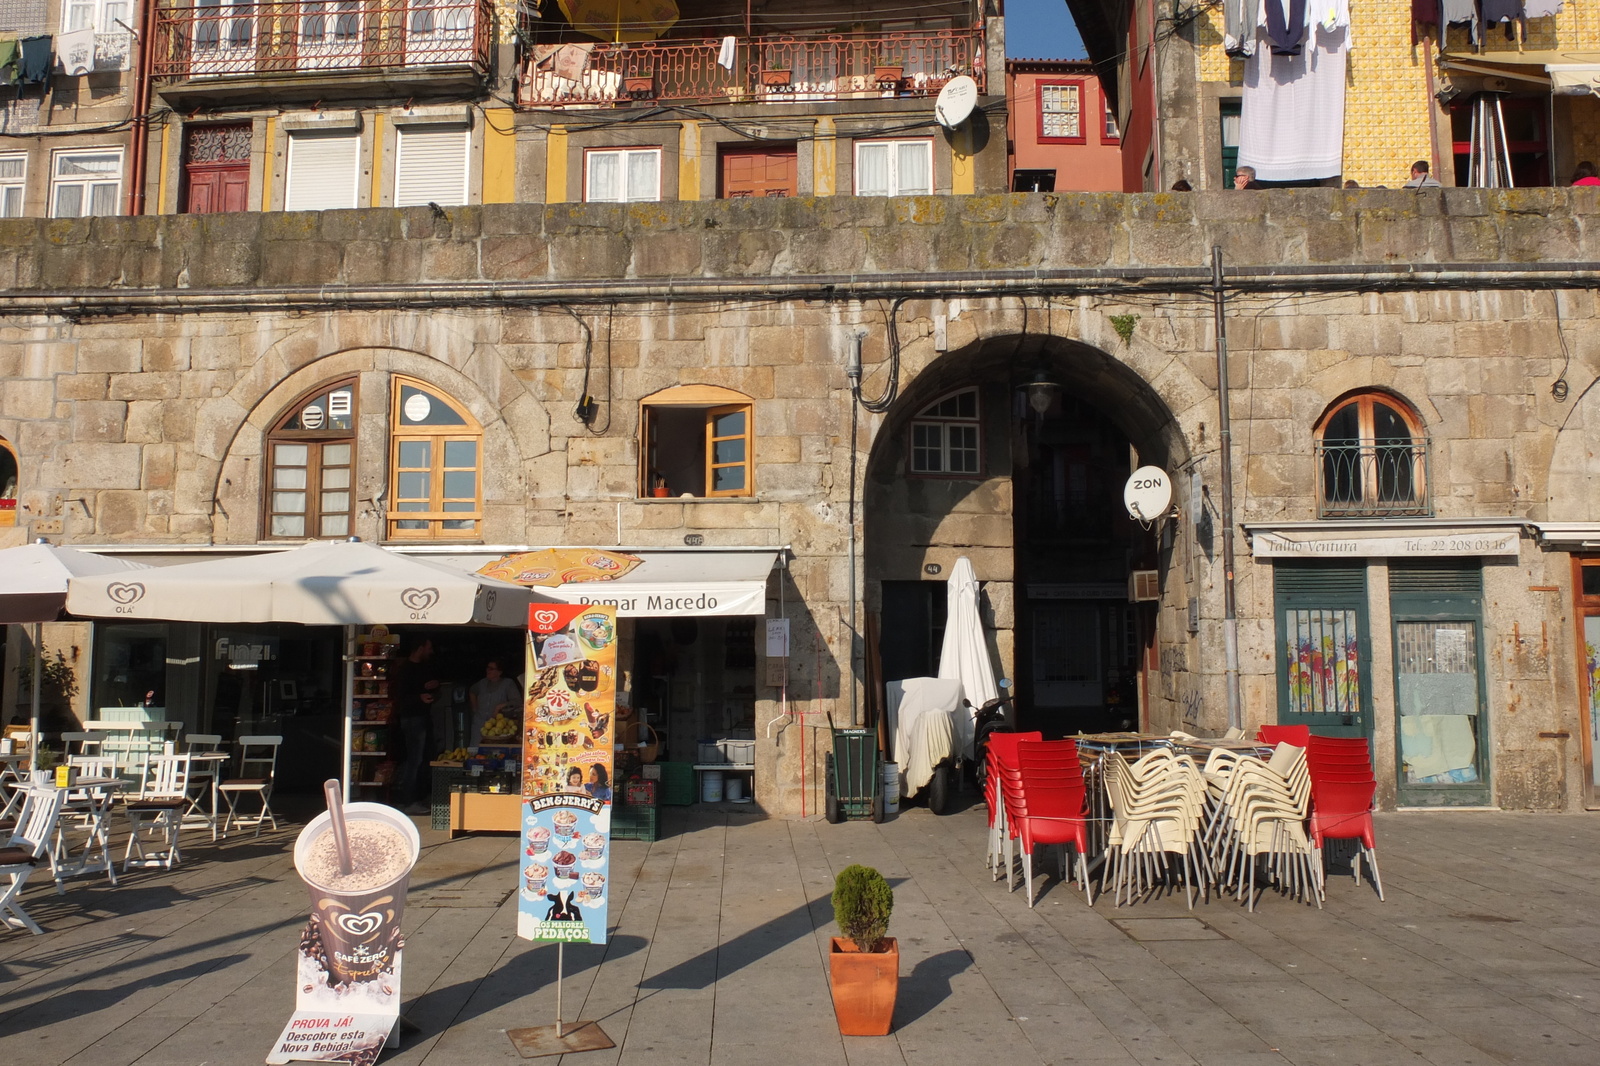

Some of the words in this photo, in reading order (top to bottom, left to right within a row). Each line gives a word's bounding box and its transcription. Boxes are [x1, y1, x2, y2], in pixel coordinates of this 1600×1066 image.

[1133, 478, 1162, 490] ZON
[1308, 540, 1357, 552] Ventura
[1431, 540, 1445, 551] 22
[1449, 540, 1471, 551] 208
[1475, 540, 1489, 551] 03
[1492, 540, 1506, 550] 16
[927, 565, 938, 573] 44
[647, 593, 718, 611] Macedo
[540, 921, 550, 929] OS
[551, 921, 584, 929] MAIORES
[535, 928, 589, 941] PEDAÇOS
[291, 1018, 330, 1030] PROVA
[334, 1015, 354, 1028] JÁ!
[286, 1031, 337, 1042] Descobre
[341, 1029, 365, 1041] esta
[280, 1043, 309, 1053] Nova
[312, 1040, 354, 1053] Bebida!
